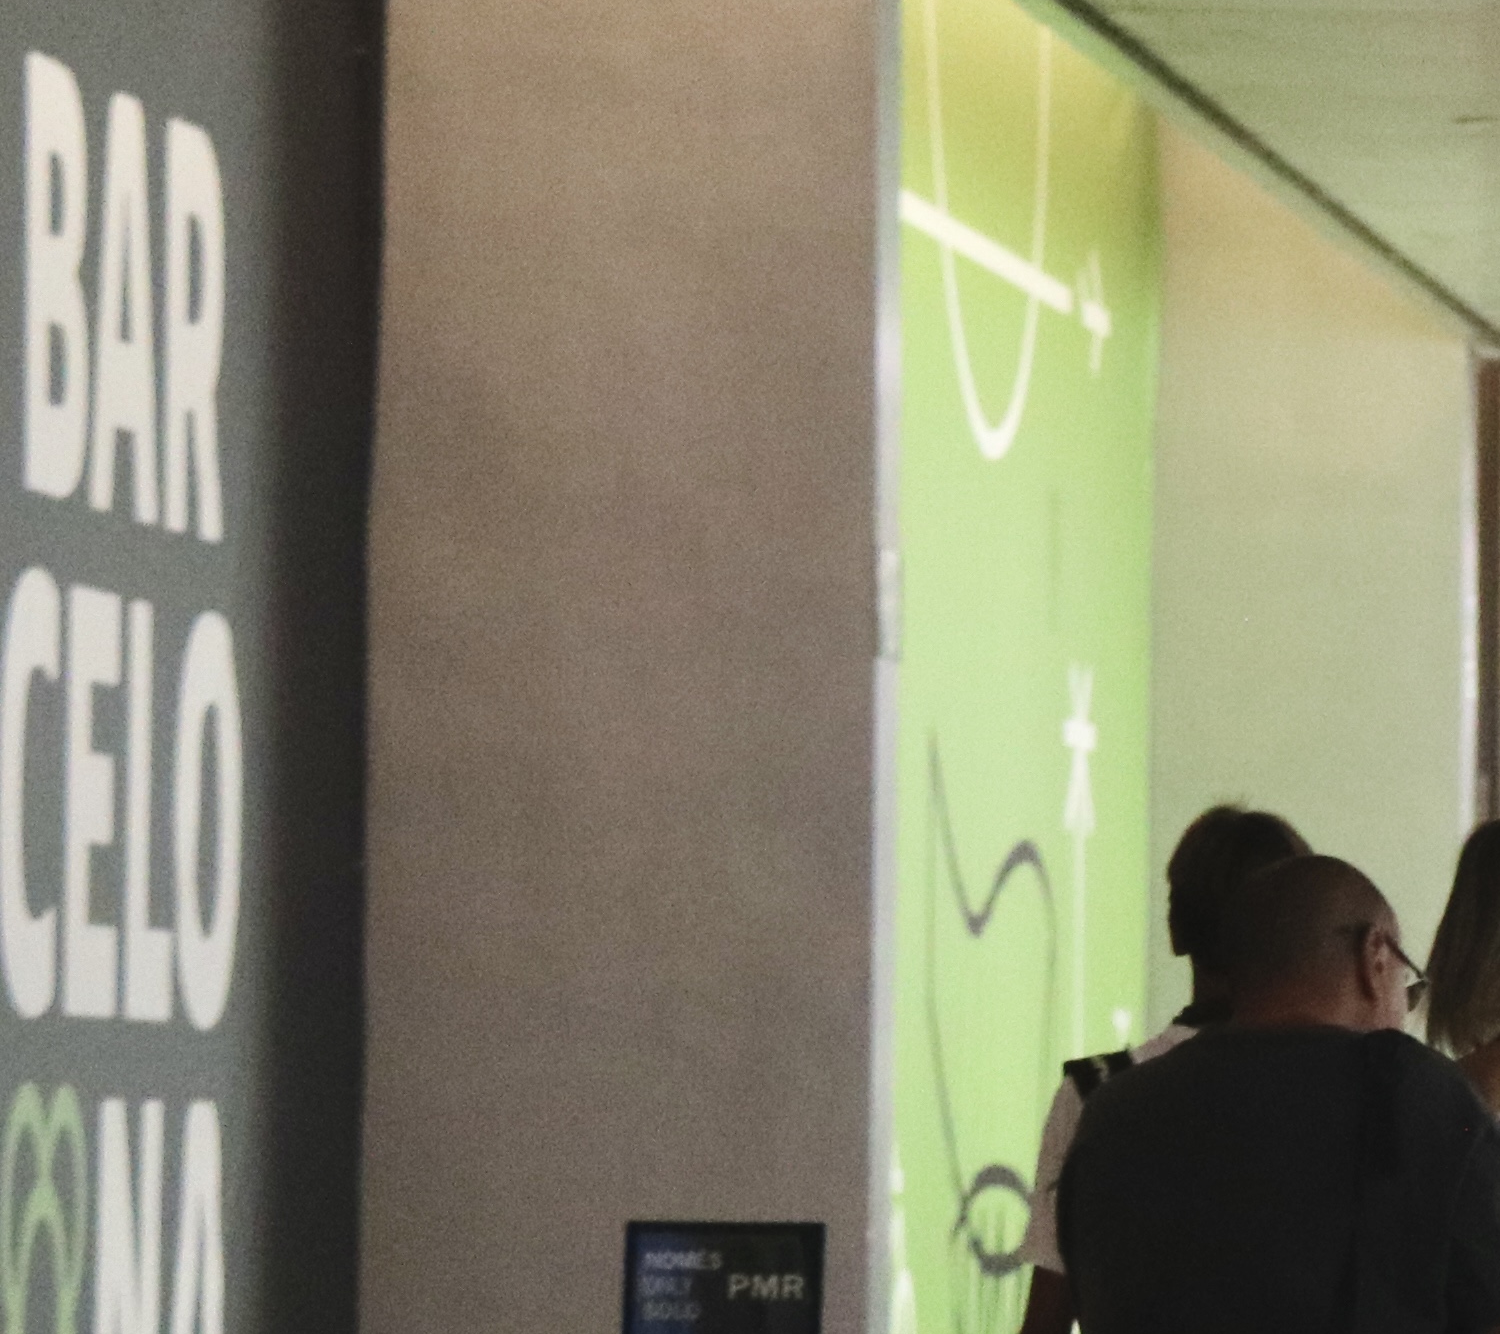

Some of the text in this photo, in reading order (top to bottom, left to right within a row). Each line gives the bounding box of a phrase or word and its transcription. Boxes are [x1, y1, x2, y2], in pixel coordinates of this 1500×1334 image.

[22, 49, 228, 543] BAR
[0, 565, 244, 1033] CELO
[728, 1273, 805, 1301] PMR
